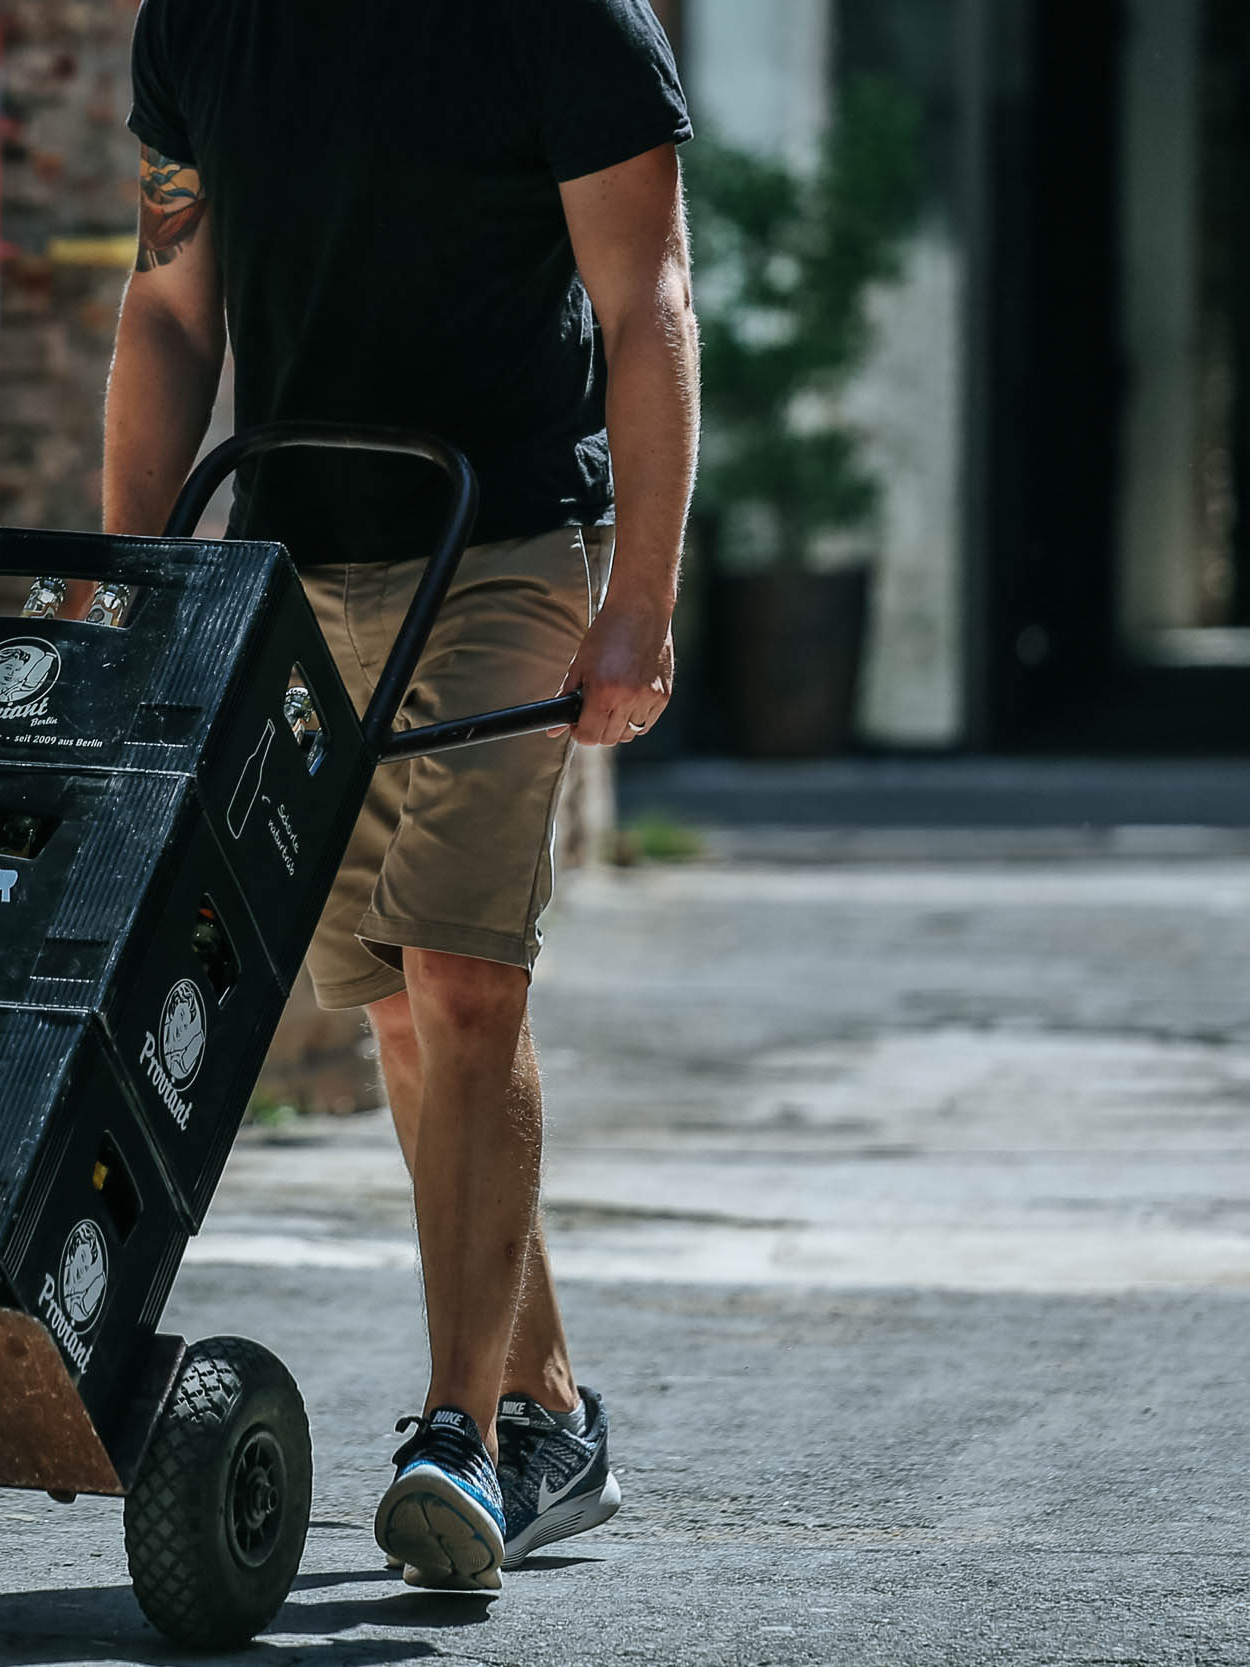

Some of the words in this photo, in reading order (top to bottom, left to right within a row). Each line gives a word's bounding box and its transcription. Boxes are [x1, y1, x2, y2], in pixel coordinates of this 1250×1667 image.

[29, 716, 58, 727] Berlin
[14, 734, 31, 743] seit
[32, 735, 57, 745] 2009
[57, 738, 74, 746] aus
[75, 738, 103, 748] Berlin
[139, 1031, 193, 1131] Proviant
[38, 1272, 95, 1375] Proviant
[501, 1401, 527, 1415] NIKE
[432, 1410, 465, 1427] NIKE
